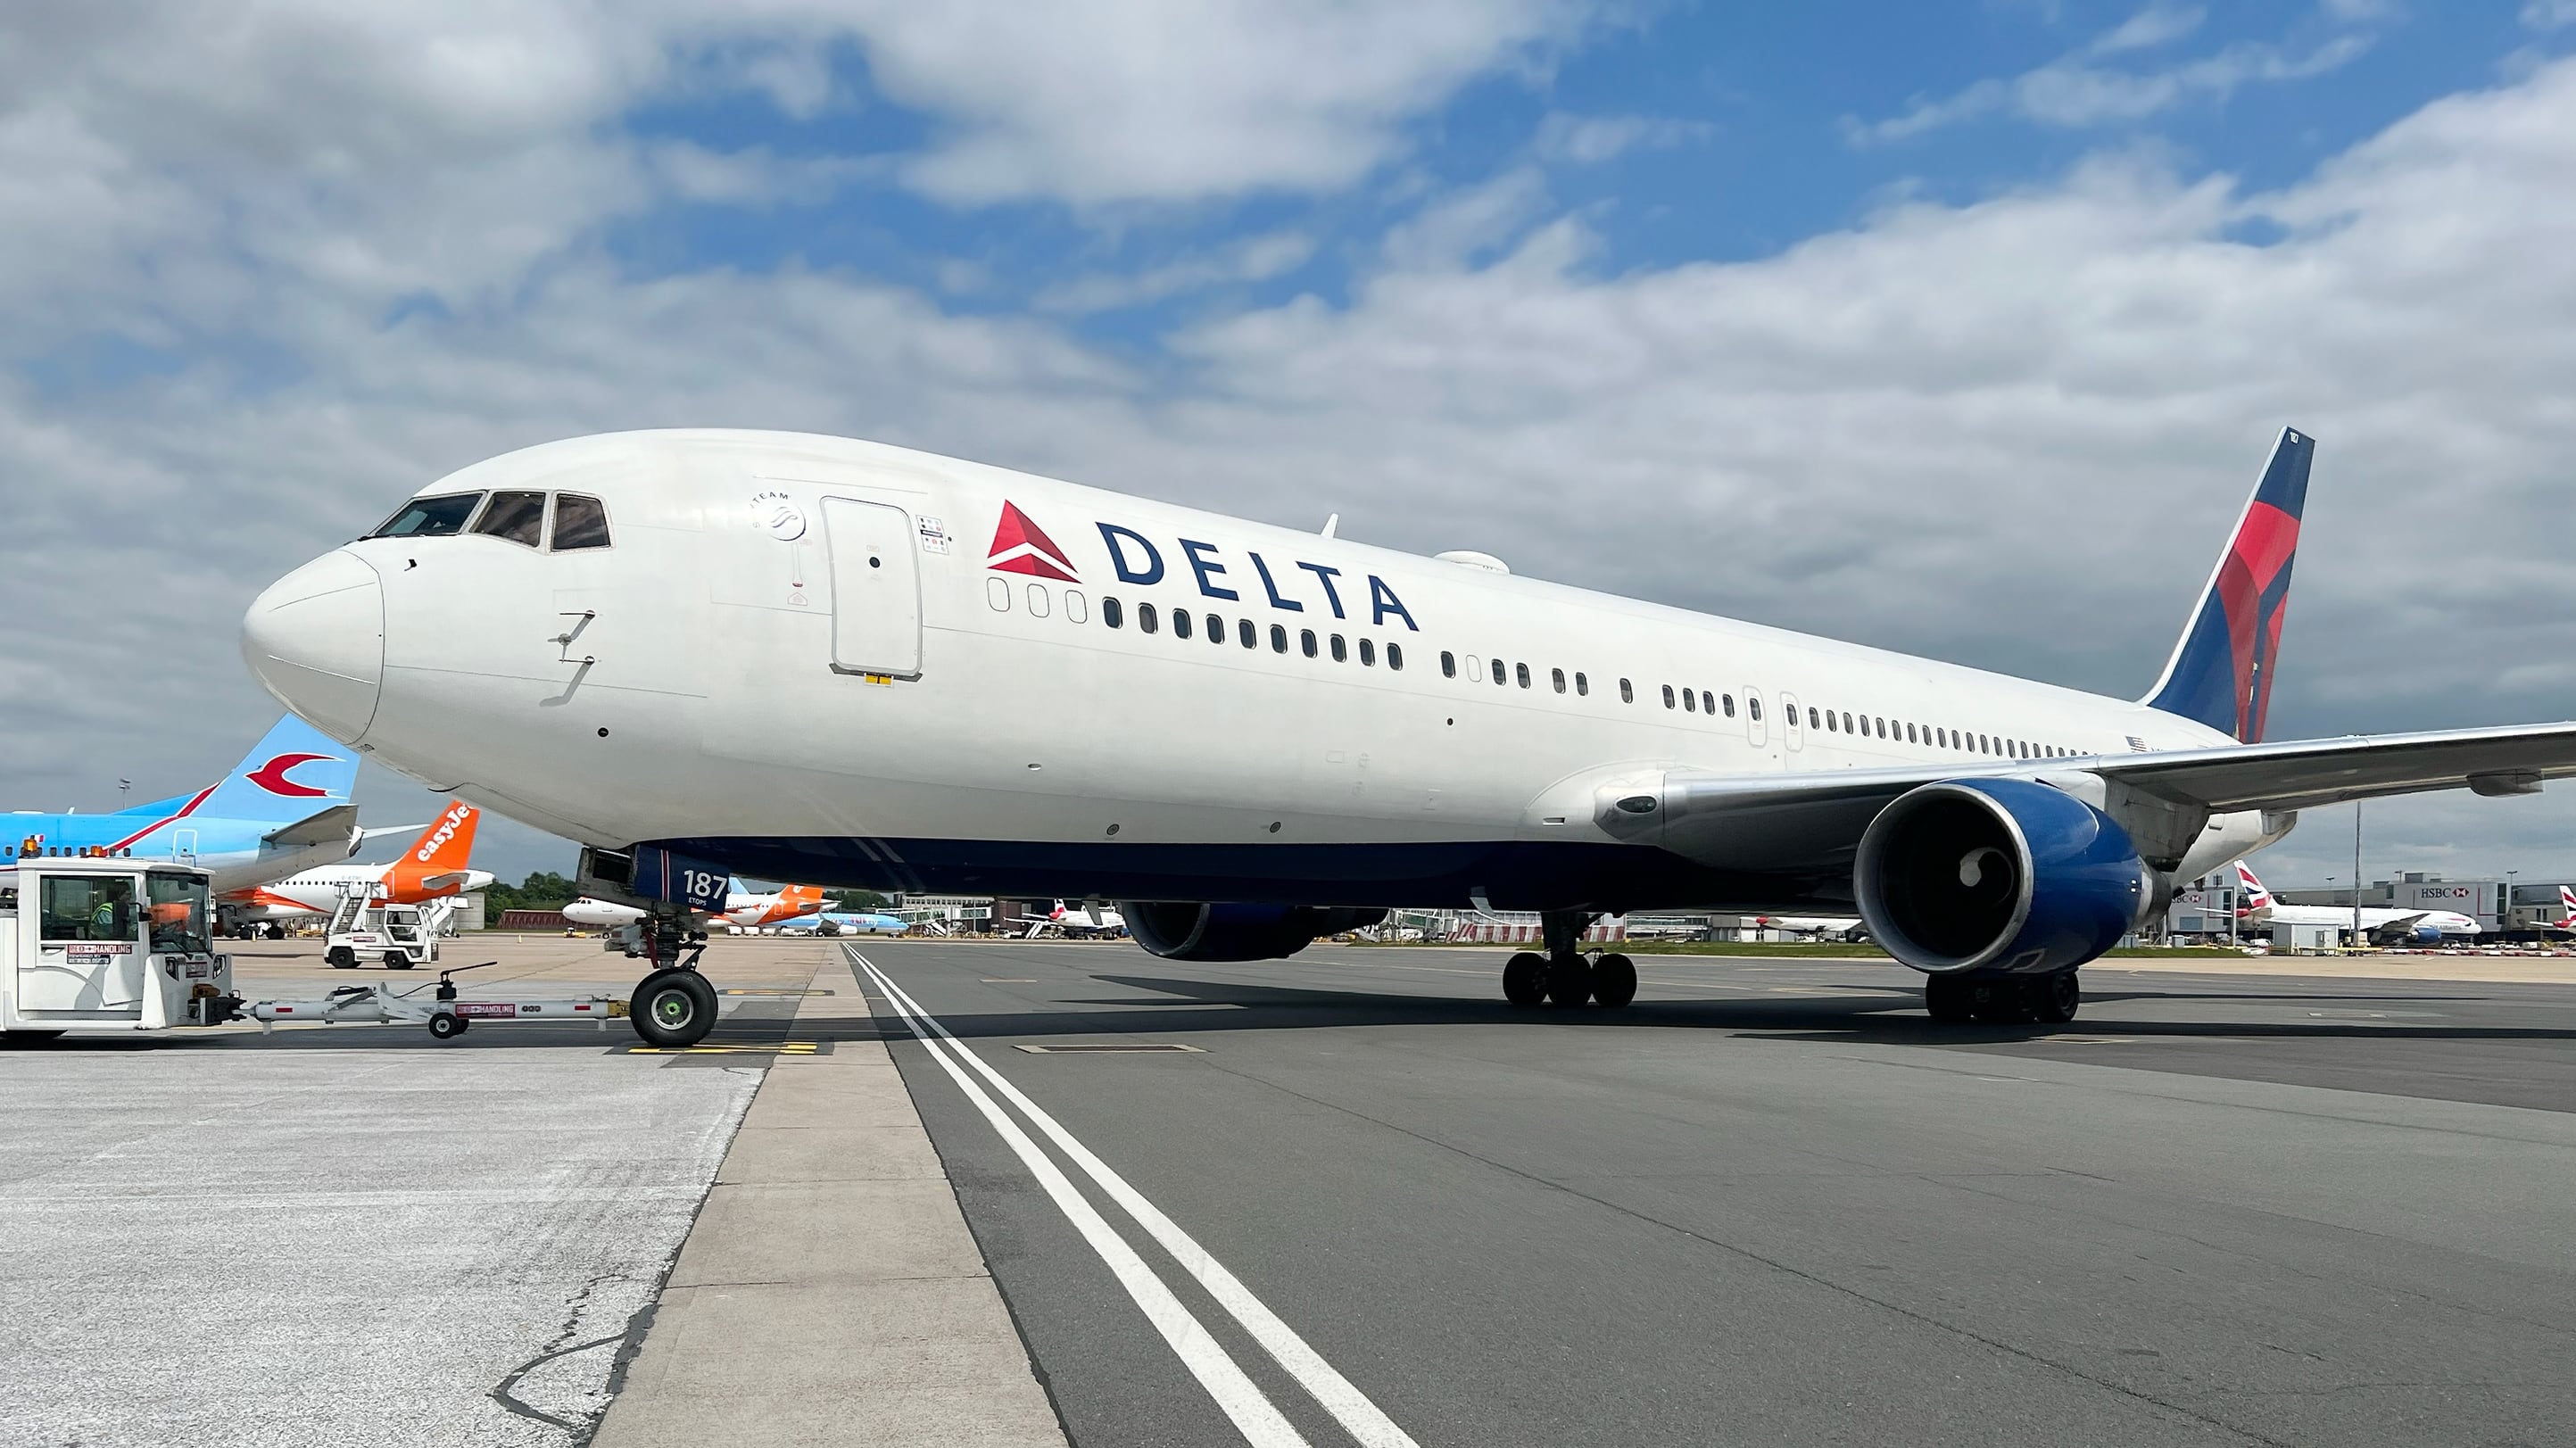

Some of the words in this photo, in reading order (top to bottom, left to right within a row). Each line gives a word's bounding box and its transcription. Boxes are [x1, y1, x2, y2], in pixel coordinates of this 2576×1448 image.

[1096, 521, 1420, 632] DELTA
[418, 803, 471, 863] easyJe
[683, 870, 728, 900] 187
[2421, 888, 2451, 898] HSBC
[688, 897, 708, 906] ETOPS
[2172, 894, 2189, 903] SBC
[95, 945, 131, 953] HANDLING
[480, 1005, 514, 1014] HANDLING
